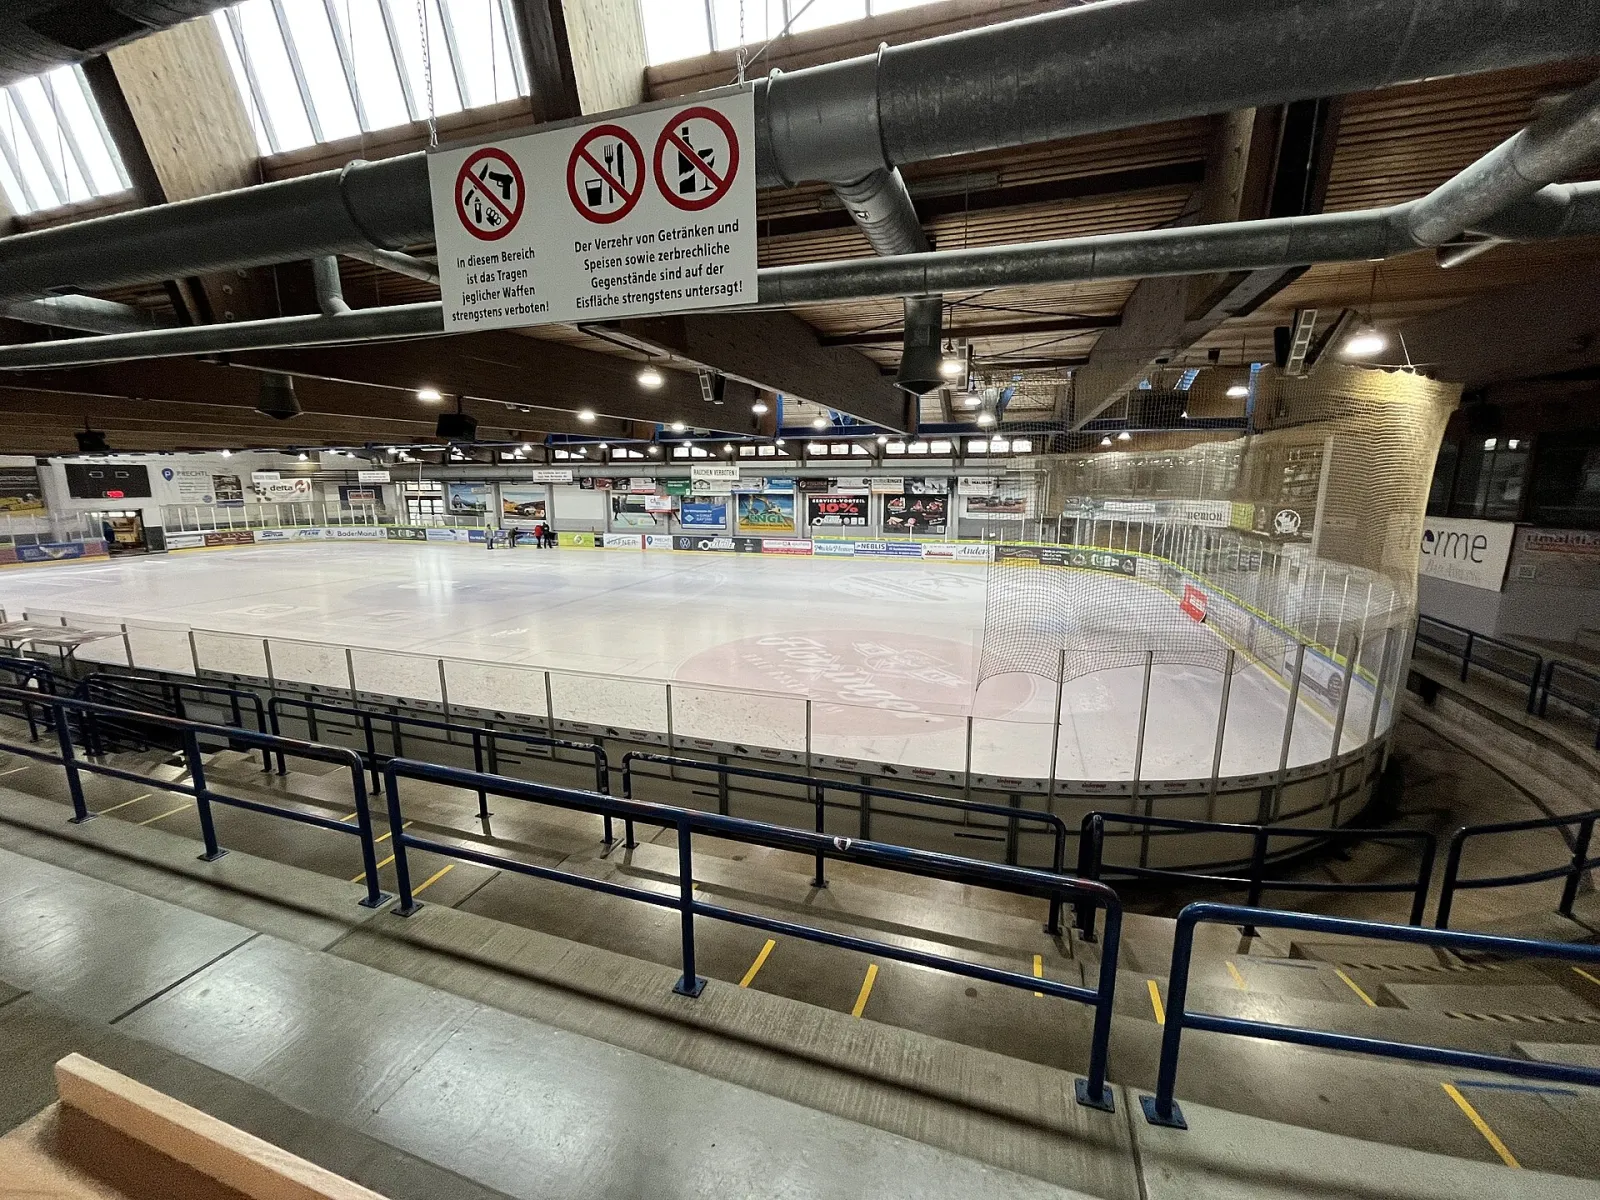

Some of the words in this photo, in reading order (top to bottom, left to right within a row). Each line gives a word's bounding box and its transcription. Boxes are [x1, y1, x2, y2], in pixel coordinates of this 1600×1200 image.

[574, 240, 592, 253] Der
[594, 235, 633, 251] Verzehr
[636, 233, 655, 246] von
[658, 224, 715, 242] Getränken
[717, 219, 739, 235] und
[456, 257, 466, 268] In
[468, 253, 499, 267] diesem
[501, 247, 535, 263] Bereich
[584, 256, 623, 273] Speisen
[625, 252, 655, 267] sowie
[657, 242, 730, 263] zerbrechliche
[466, 272, 478, 285] ist
[479, 271, 495, 284] das
[497, 268, 528, 284] Tragen
[591, 270, 657, 290] Gegenstände
[659, 268, 682, 282] sind
[684, 265, 703, 279] auf
[705, 262, 725, 276] der
[462, 288, 500, 306] jeglicher
[502, 285, 535, 301] Waffen
[576, 293, 620, 309] Eisfläche
[622, 288, 683, 306] strengstens
[684, 280, 743, 300] untersagt!
[452, 307, 502, 322] strengstens
[504, 301, 549, 317] verboten!
[270, 484, 293, 492] delta
[818, 503, 859, 513] 10%
[1420, 530, 1487, 563] erme
